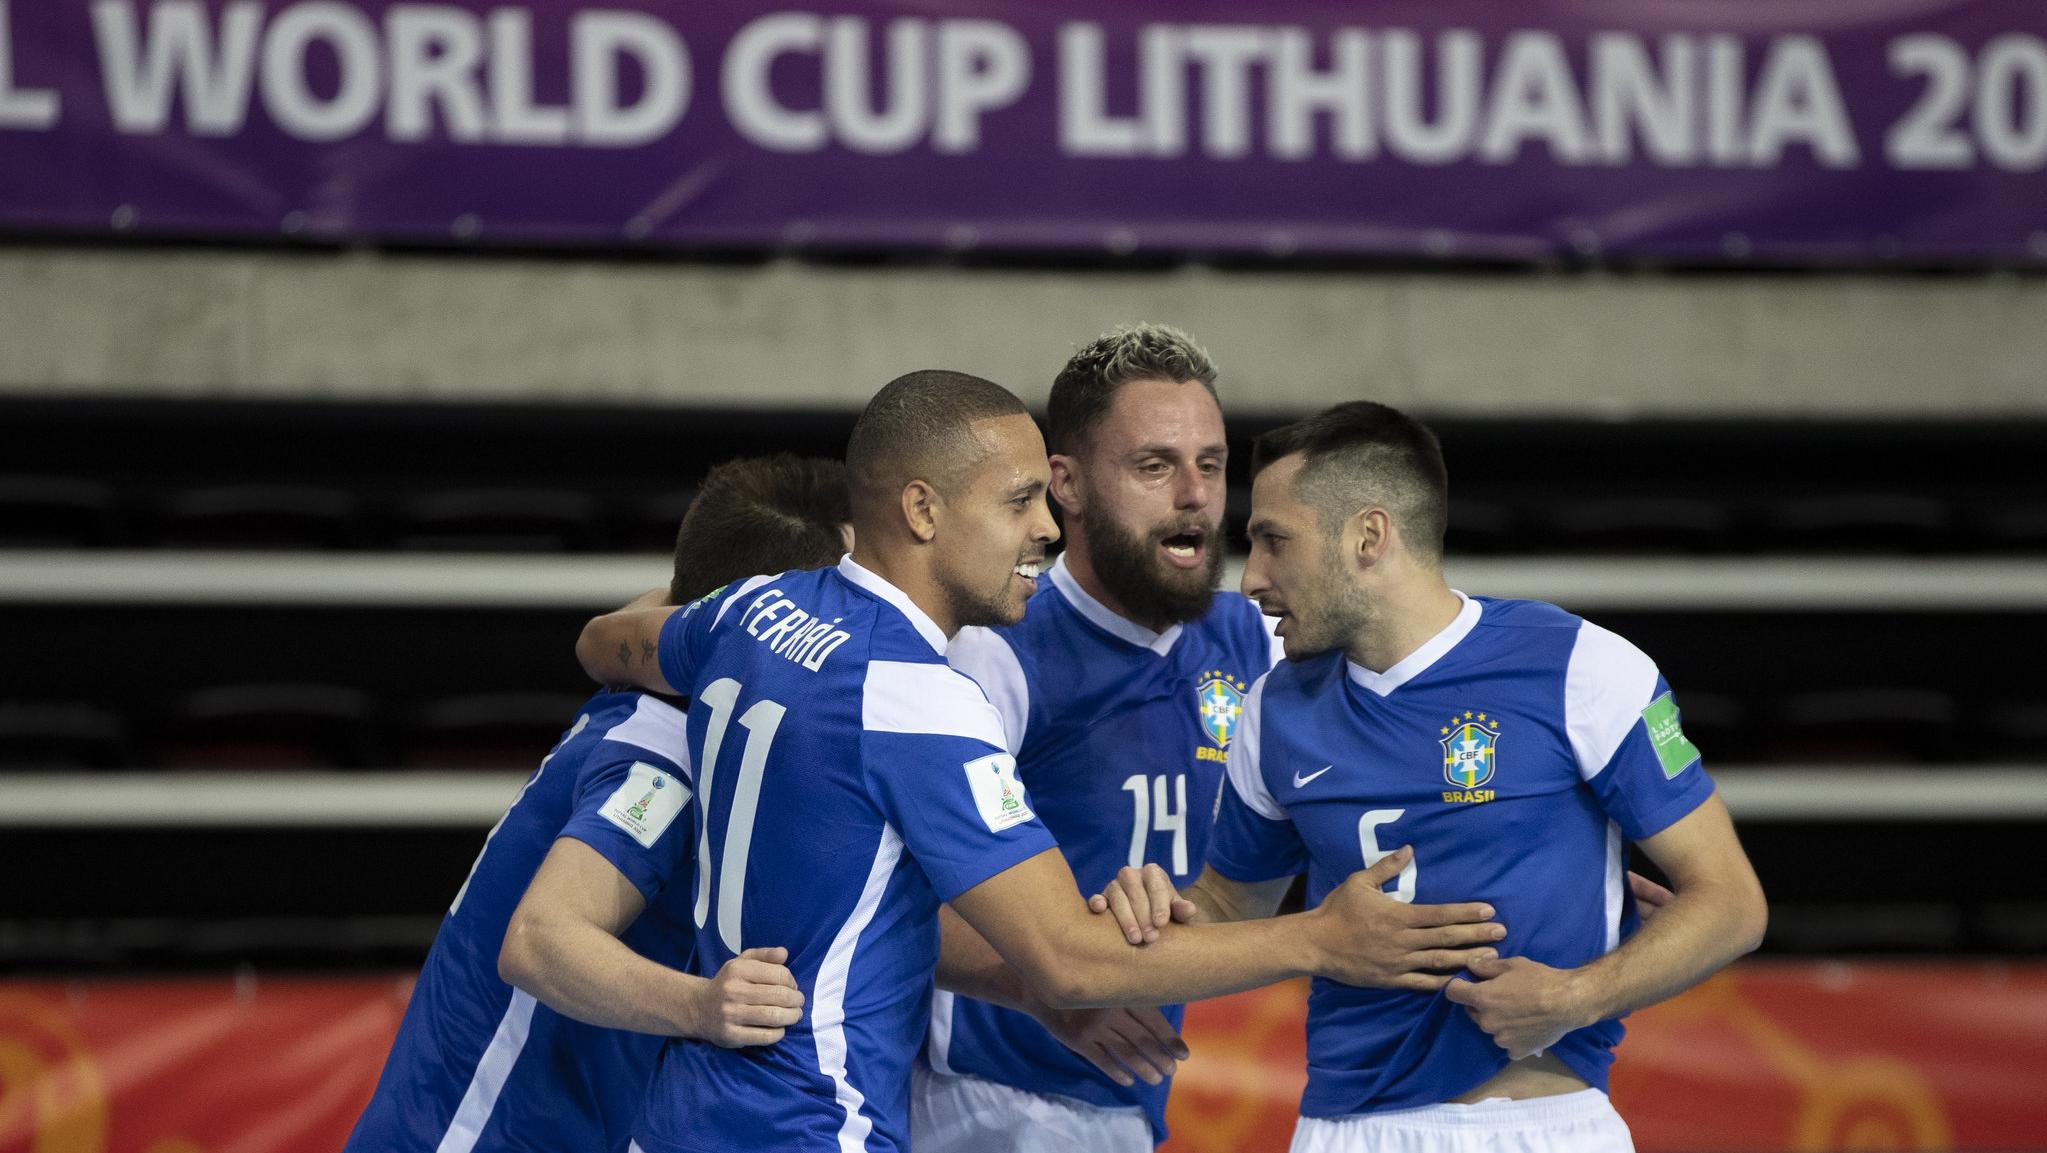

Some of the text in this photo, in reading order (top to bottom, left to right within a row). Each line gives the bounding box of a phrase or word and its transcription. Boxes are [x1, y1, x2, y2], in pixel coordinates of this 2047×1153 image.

[92, 0, 694, 146] WORLD
[720, 12, 1032, 154] CUP
[1058, 23, 1860, 168] LITHUANIA
[1886, 34, 2047, 172] 20
[694, 677, 787, 956] 11
[1459, 751, 1480, 760] CBF
[1121, 773, 1188, 876] 14
